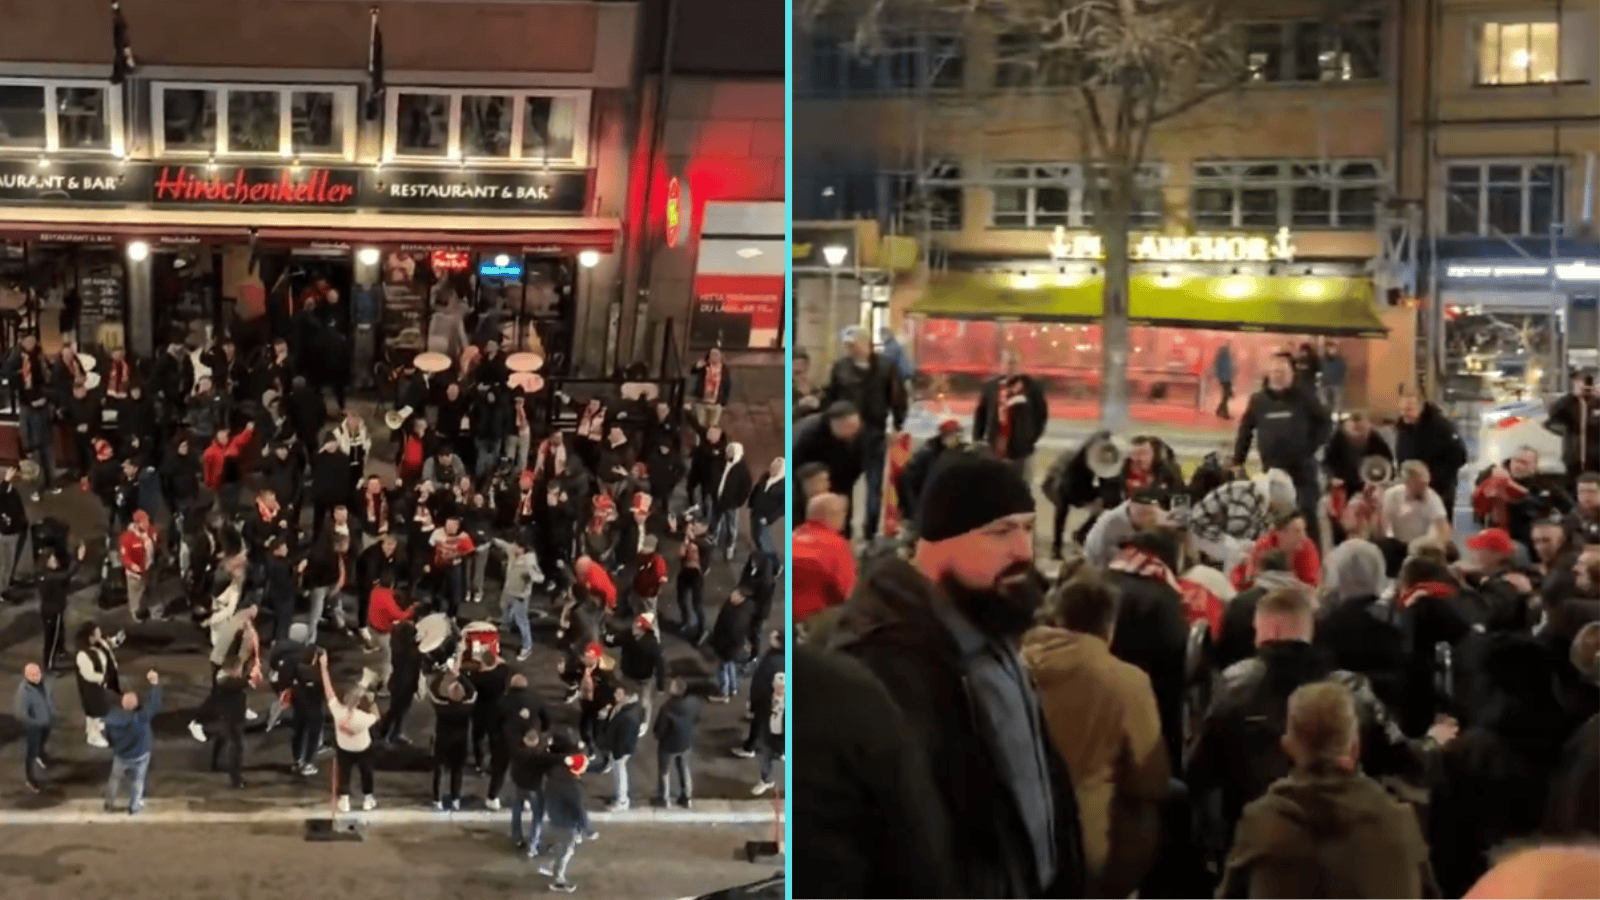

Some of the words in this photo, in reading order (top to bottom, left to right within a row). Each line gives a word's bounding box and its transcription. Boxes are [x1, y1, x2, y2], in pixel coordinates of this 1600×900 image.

[0, 174, 65, 189] URANT
[67, 176, 79, 190] &
[83, 176, 116, 190] BAR
[154, 165, 353, 204] Hirschenkeller
[390, 183, 499, 199] RESTAURANT
[501, 185, 512, 199] &
[516, 186, 549, 200] BAR
[1136, 235, 1270, 261] ANCHOR
